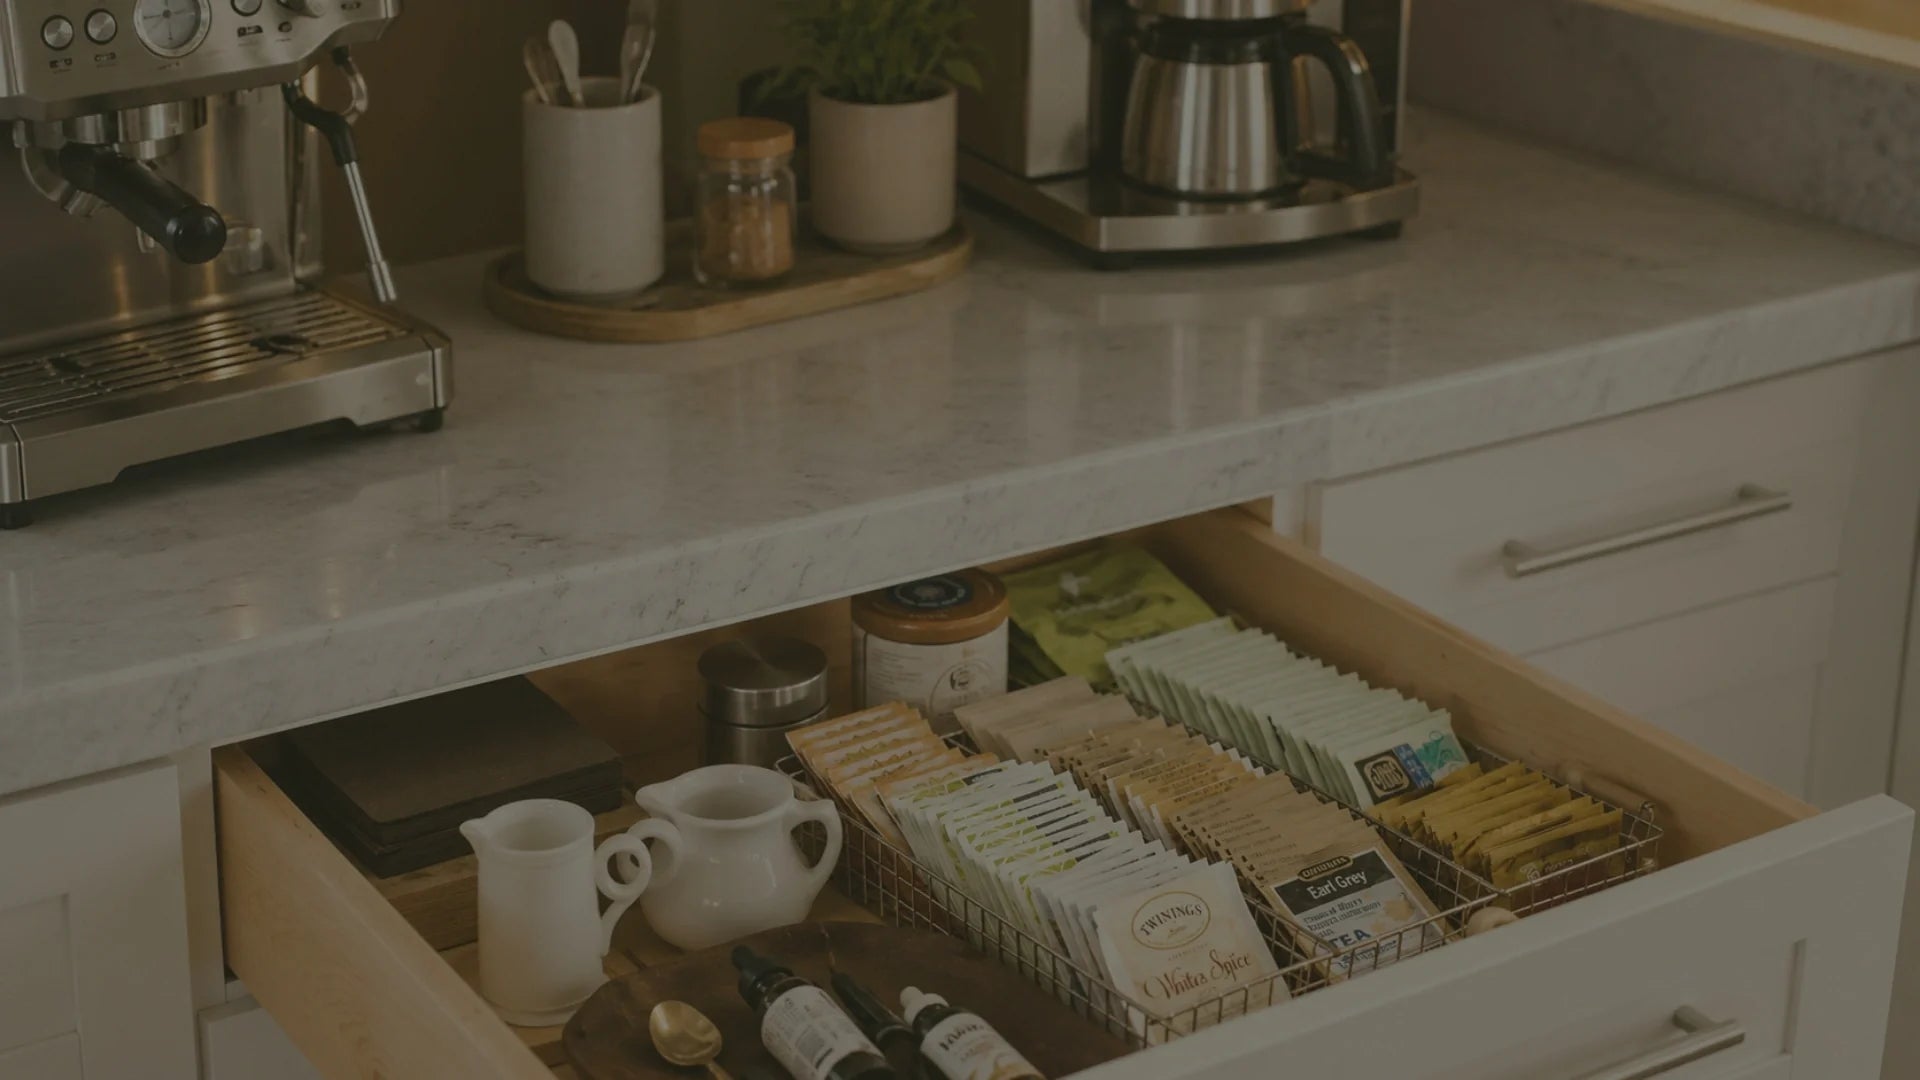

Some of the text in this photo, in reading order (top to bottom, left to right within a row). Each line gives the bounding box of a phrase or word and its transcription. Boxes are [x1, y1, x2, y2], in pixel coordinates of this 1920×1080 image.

[1307, 871, 1367, 899] Earl Grey
[1140, 904, 1202, 936] TWININGS
[1327, 928, 1371, 949] TEA
